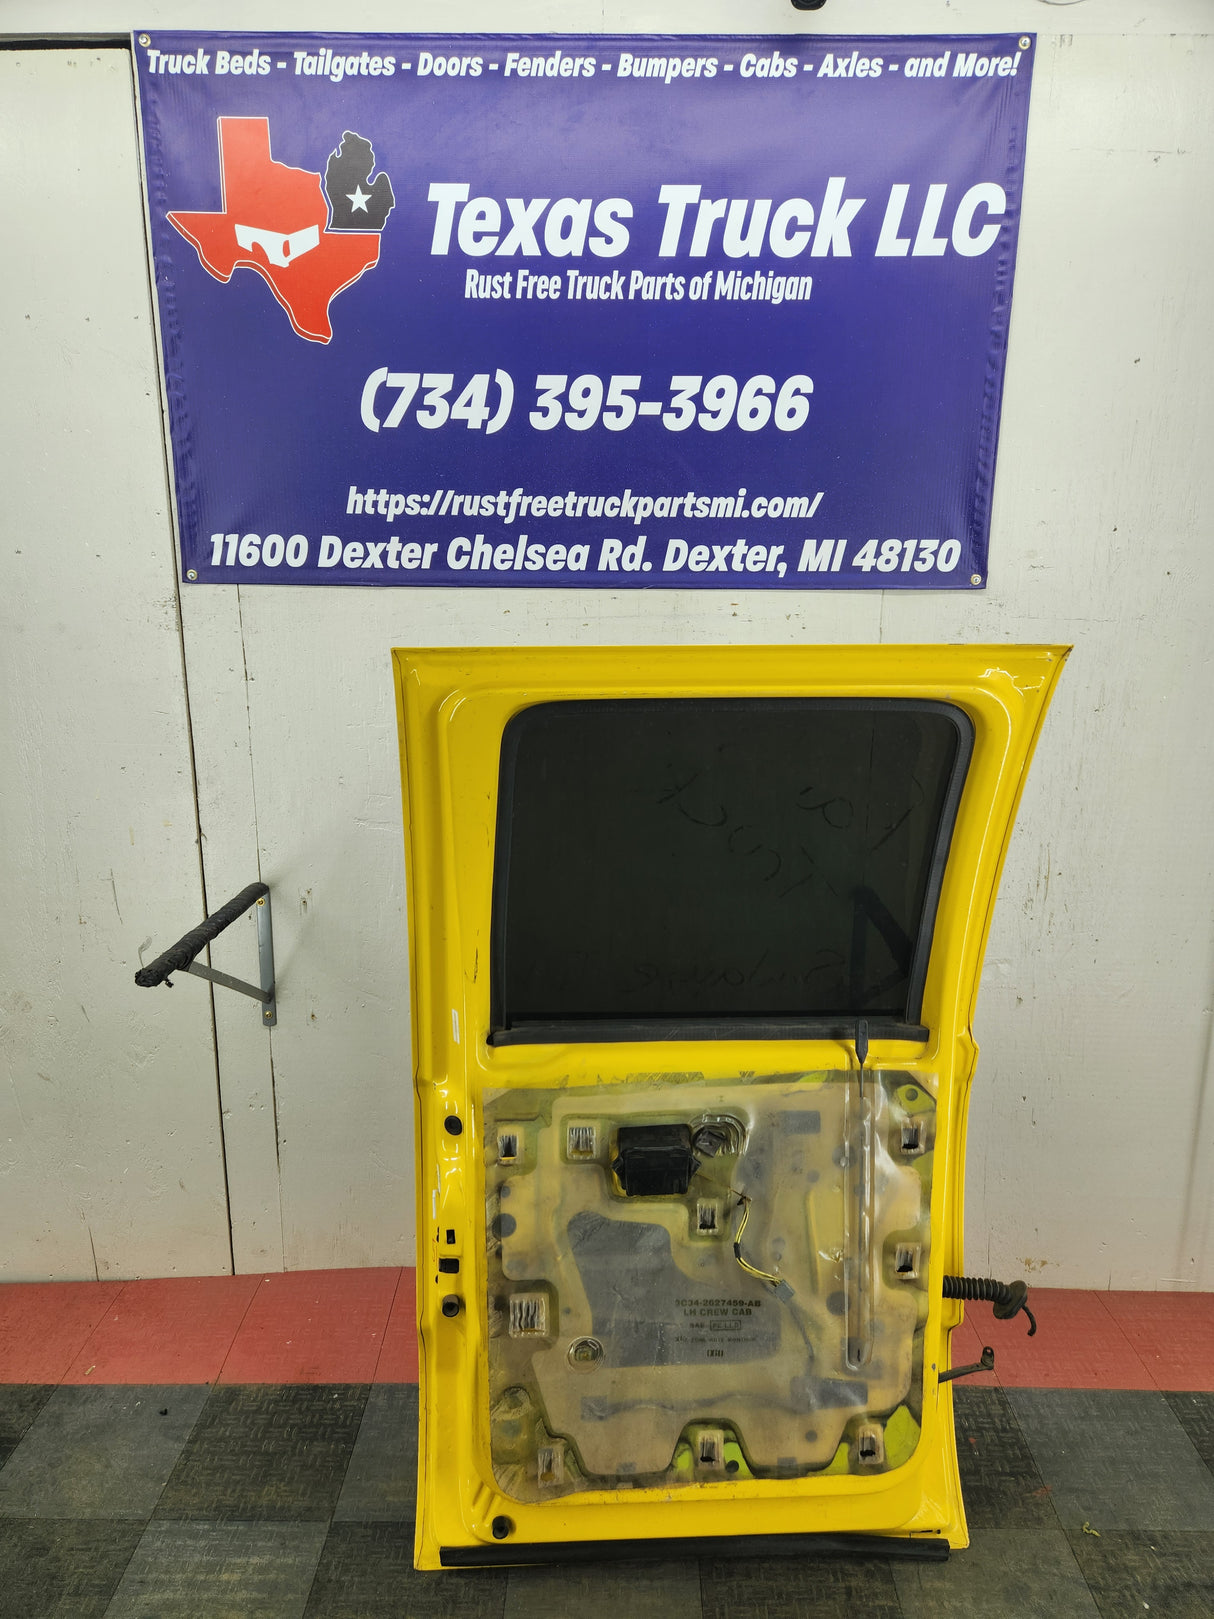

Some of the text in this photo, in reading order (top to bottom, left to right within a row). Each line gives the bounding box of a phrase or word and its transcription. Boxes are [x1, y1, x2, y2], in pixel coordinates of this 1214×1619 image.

[147, 49, 211, 75] Truck
[214, 50, 272, 76] Beds
[293, 49, 397, 83] Tailgates
[416, 51, 484, 77] Doors
[503, 51, 597, 78] Fenders
[616, 52, 719, 84] Bumpers
[739, 51, 799, 78] Cabs
[816, 51, 884, 78] Axles
[904, 51, 951, 78] and
[952, 51, 1022, 77] More!
[427, 176, 1008, 259] Texas Truck LLC
[464, 268, 813, 305] Rust Free Truck Parts of Michigan
[360, 366, 815, 435] (734) 395-3966
[345, 485, 825, 525] https://rustfreetruckpartsmi.com/
[210, 532, 962, 578] 11600 Dexter Chelsea Rd. Dexter, MI 48130
[684, 1308, 752, 1316] LH CREW CAB
